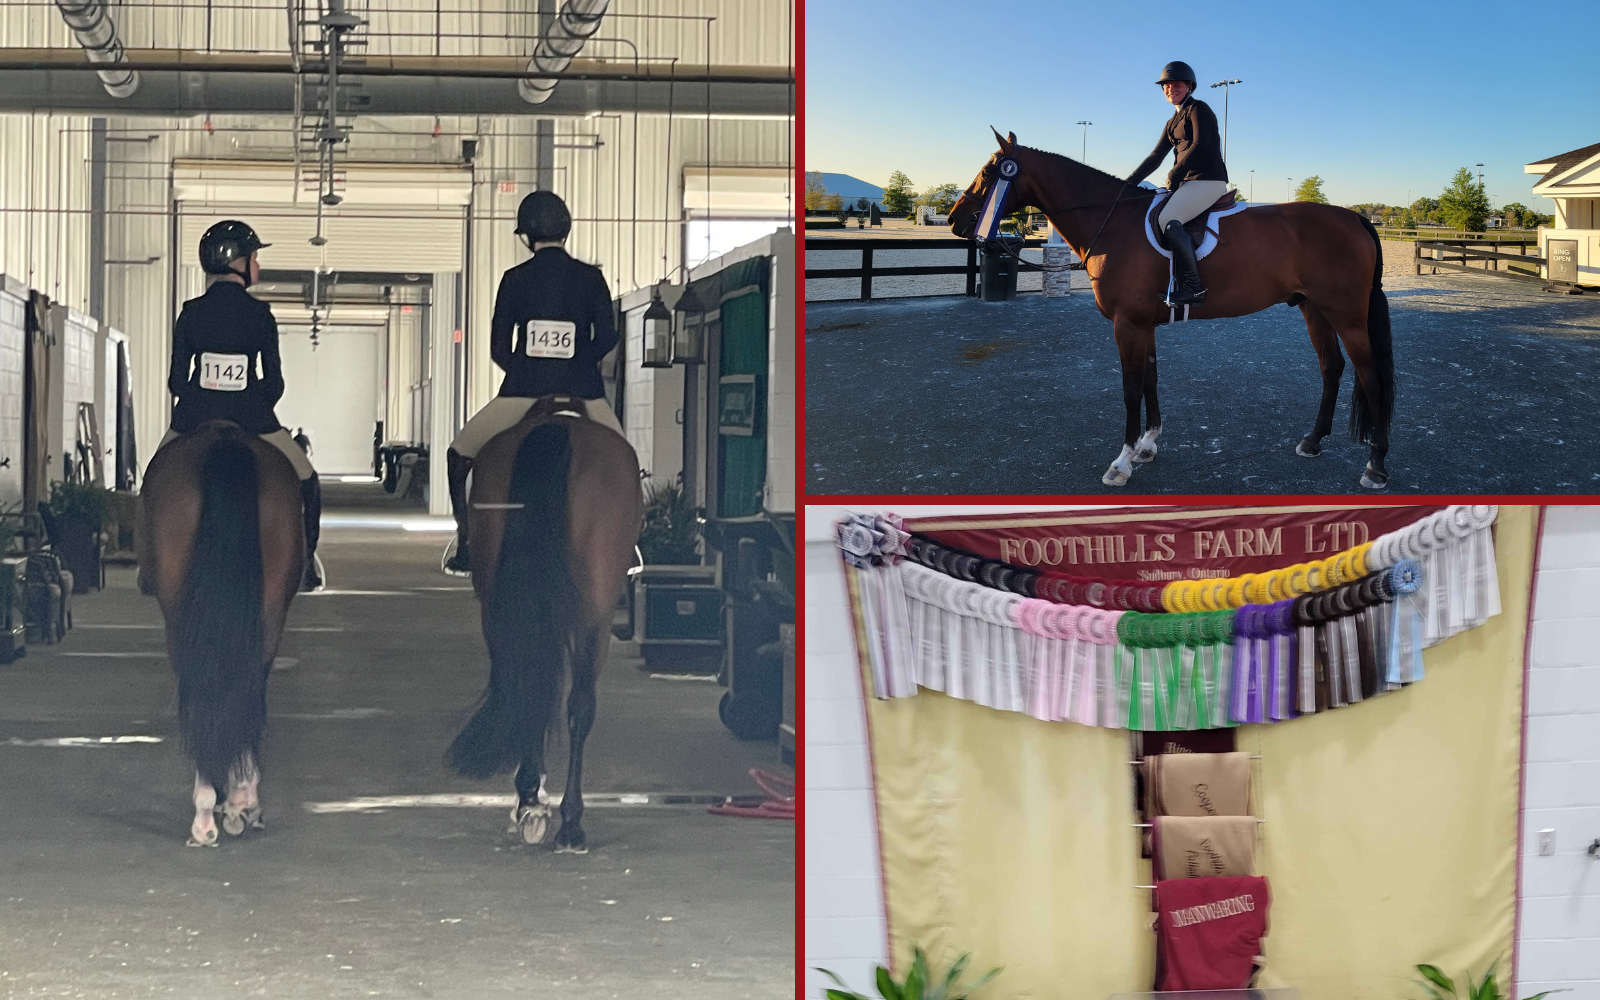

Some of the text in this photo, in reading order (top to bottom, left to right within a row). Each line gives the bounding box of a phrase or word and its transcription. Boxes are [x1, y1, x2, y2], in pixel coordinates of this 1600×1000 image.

[530, 330, 571, 348] 1436
[204, 362, 245, 381] 1142
[999, 520, 1370, 566] FOOTHILLS FARM LTD
[1188, 566, 1231, 579] Ontario
[1169, 894, 1255, 928] MANWARING
